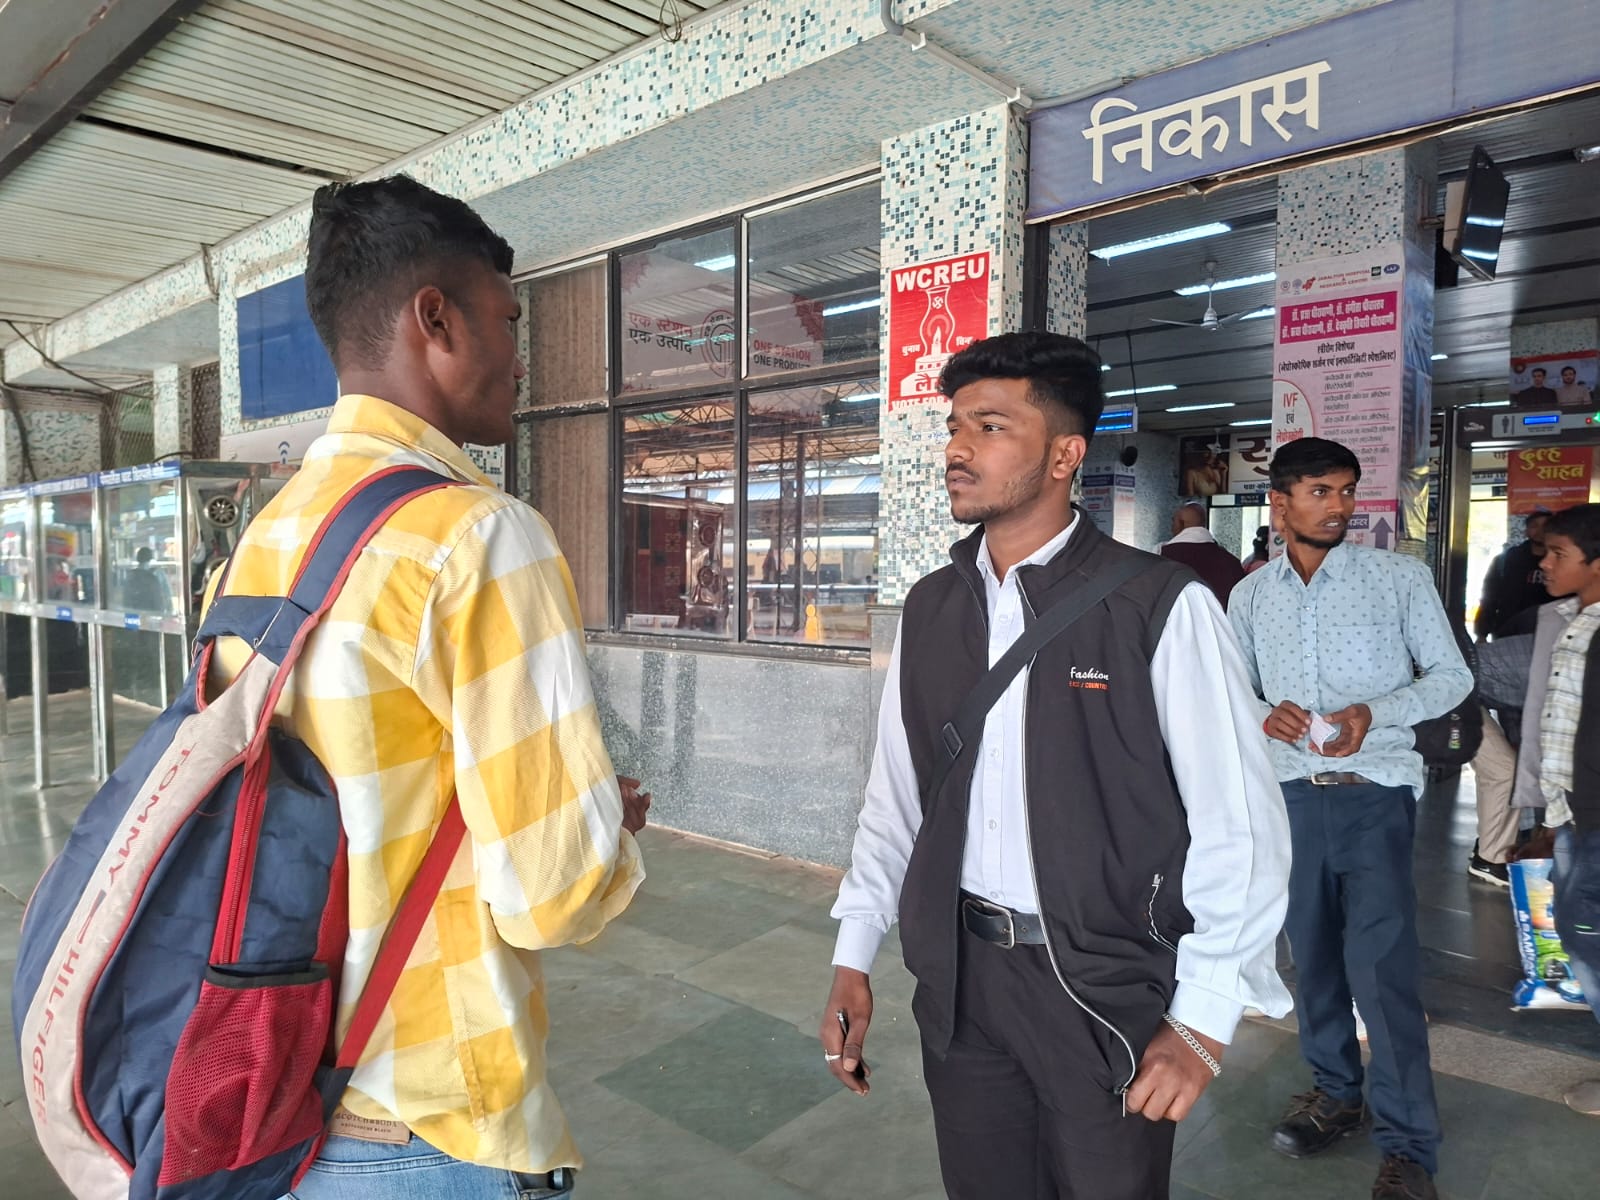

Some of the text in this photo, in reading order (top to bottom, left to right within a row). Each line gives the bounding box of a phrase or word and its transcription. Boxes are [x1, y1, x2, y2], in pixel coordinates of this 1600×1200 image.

[1082, 61, 1332, 184] निकास
[895, 257, 985, 293] WCREU
[629, 312, 651, 329] एक
[656, 315, 692, 336] स्टेशन
[629, 329, 692, 353] एक उत्पाद
[754, 339, 811, 361] ONE STATION
[902, 343, 921, 356] चुनाव
[754, 355, 772, 367] ONE
[1283, 393, 1298, 408] IVF
[109, 742, 197, 887] TOMMY
[33, 949, 79, 1125] HILFIGER
